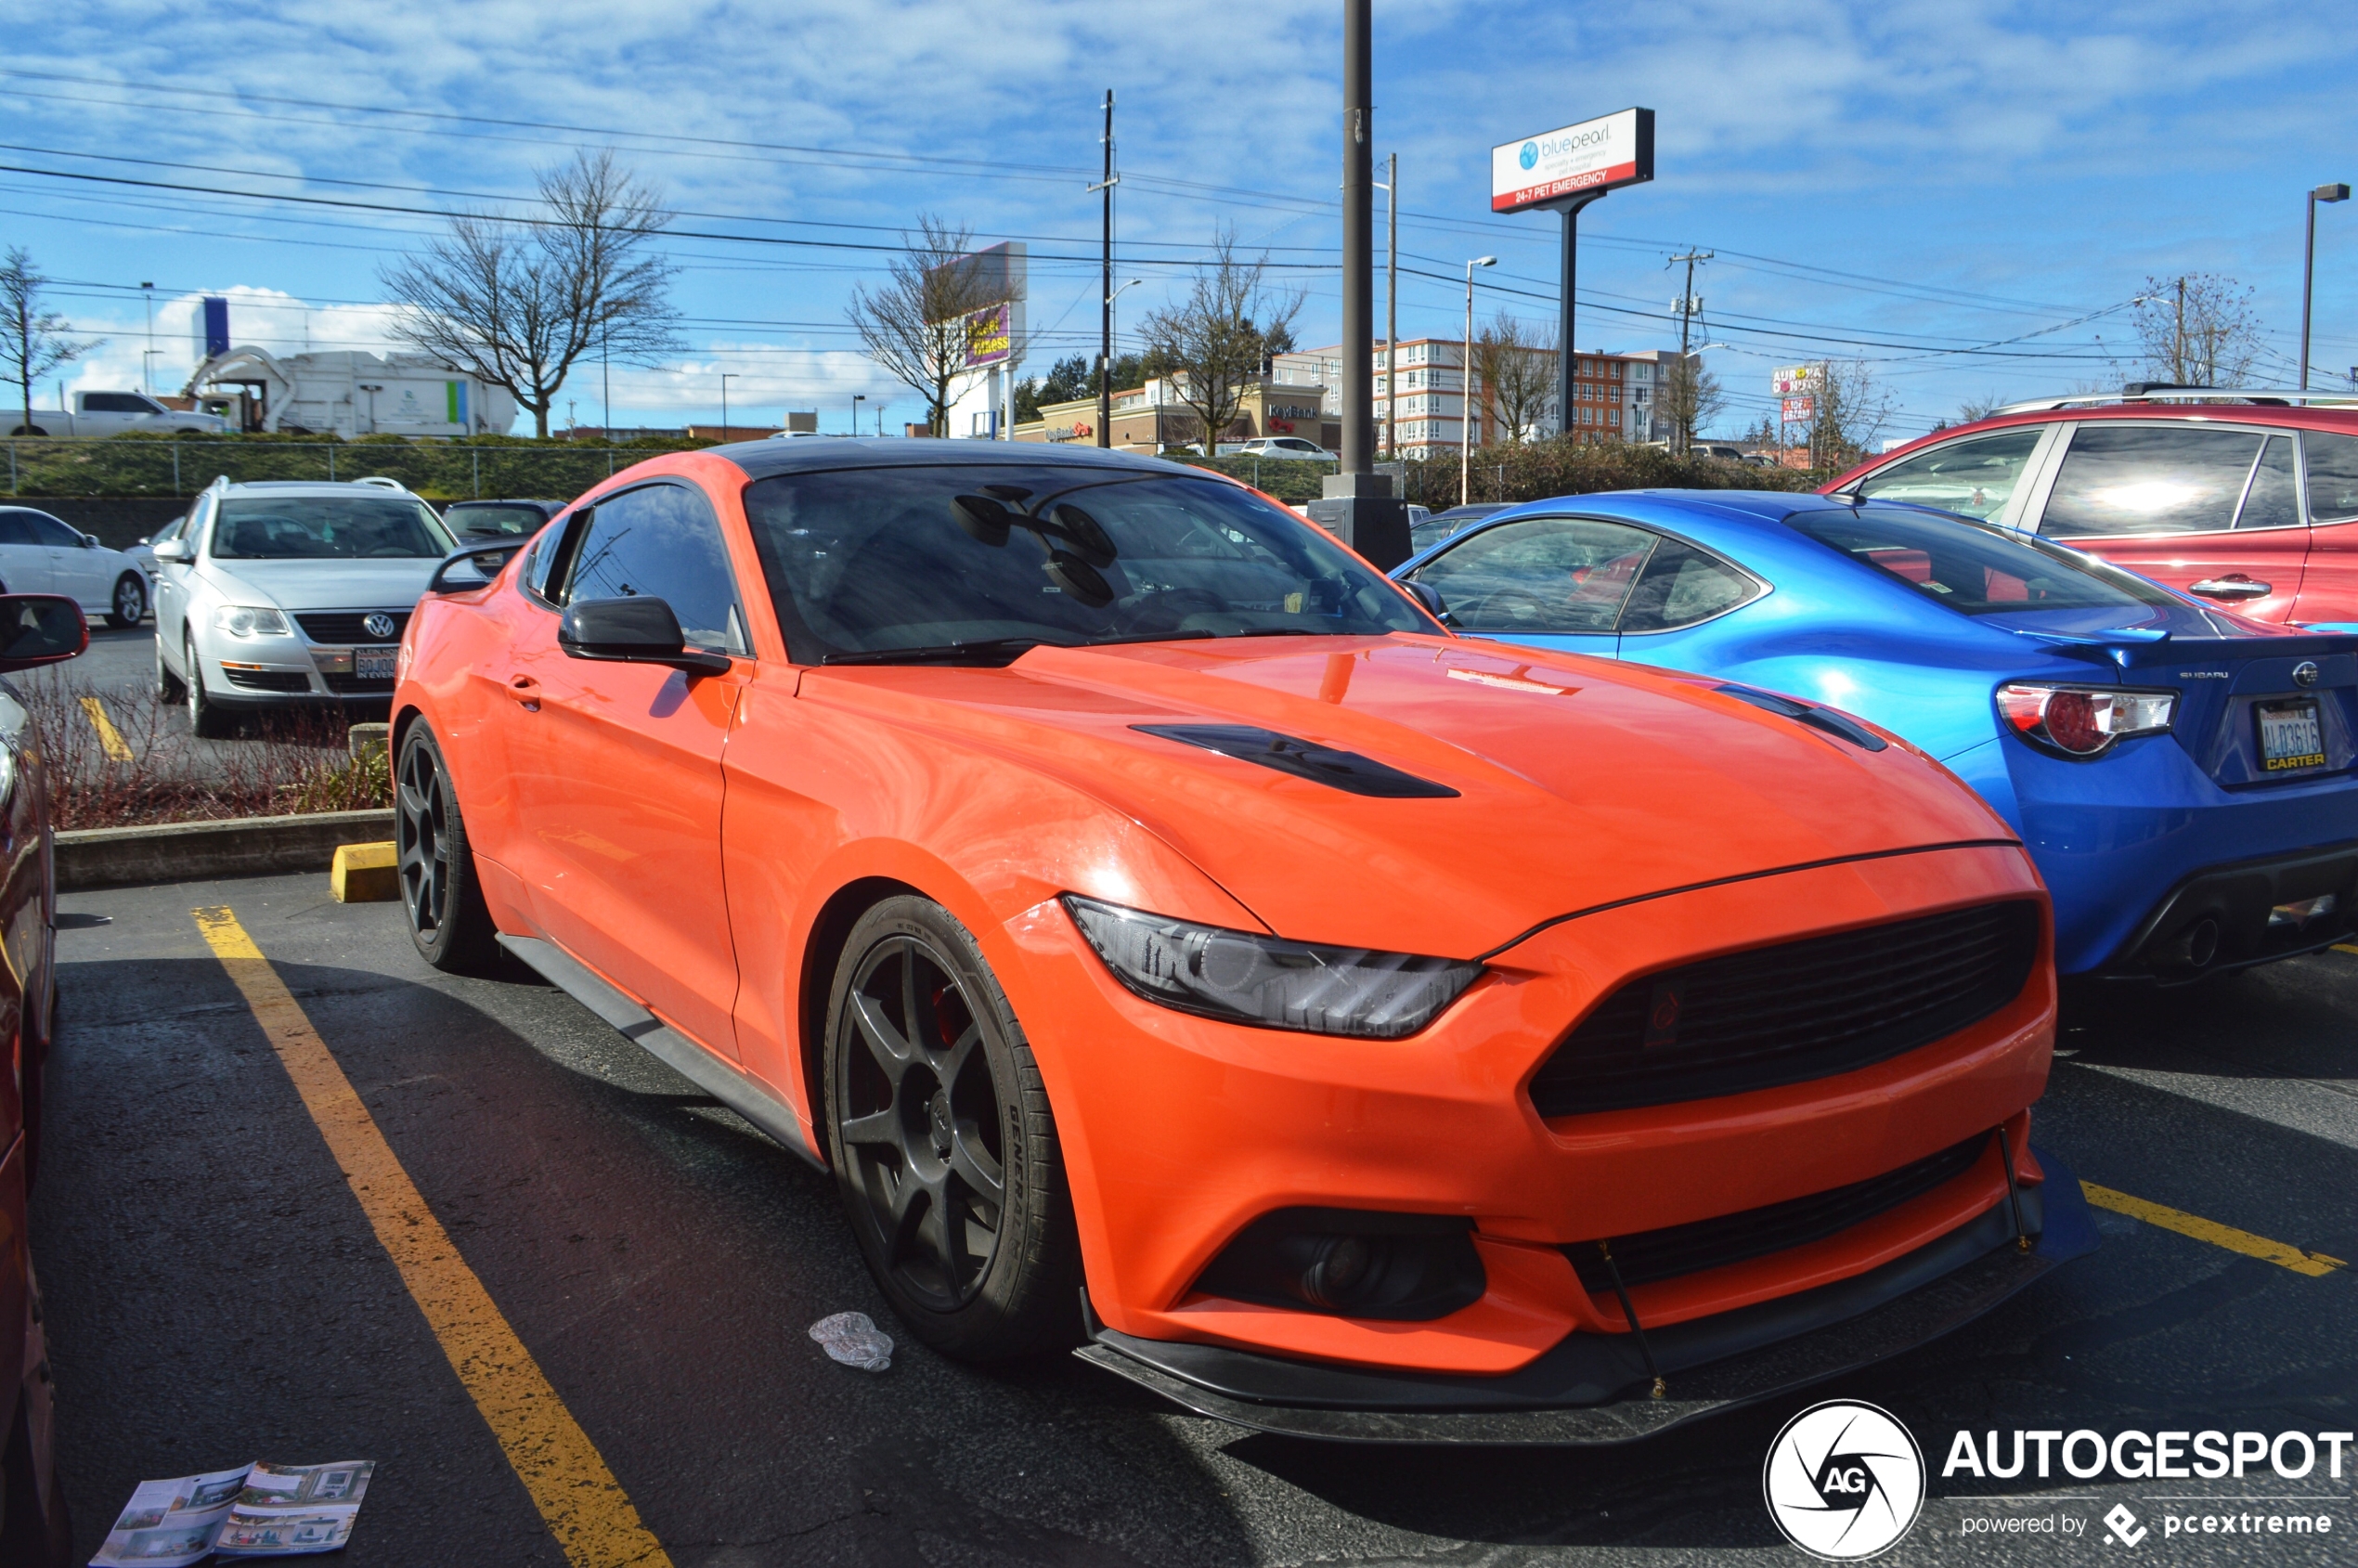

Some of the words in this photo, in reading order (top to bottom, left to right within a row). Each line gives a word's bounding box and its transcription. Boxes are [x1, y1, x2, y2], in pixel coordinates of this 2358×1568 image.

[1542, 123, 1609, 157] bluepearl
[1545, 159, 1569, 171] specialty
[1574, 149, 1607, 162] emergency
[1559, 167, 1568, 176] pet
[1569, 162, 1592, 173] hospital
[1515, 189, 1533, 203] 24-7
[1535, 185, 1550, 199] PET
[1551, 170, 1608, 194] EMERGENCY
[967, 315, 999, 337] plet
[967, 336, 1008, 356] itness
[1773, 368, 1821, 382] AURORA
[1773, 379, 1821, 394] DONUTS
[1268, 404, 1317, 419] KeyBank
[1790, 399, 1803, 409] ICE
[1783, 408, 1810, 421] CREAM
[1045, 426, 1074, 440] KeyBank
[2261, 710, 2296, 720] WASHINGTON
[2264, 721, 2319, 757] ALD3616
[2266, 753, 2325, 771] CARTER
[1009, 1104, 1024, 1233] GENERAL
